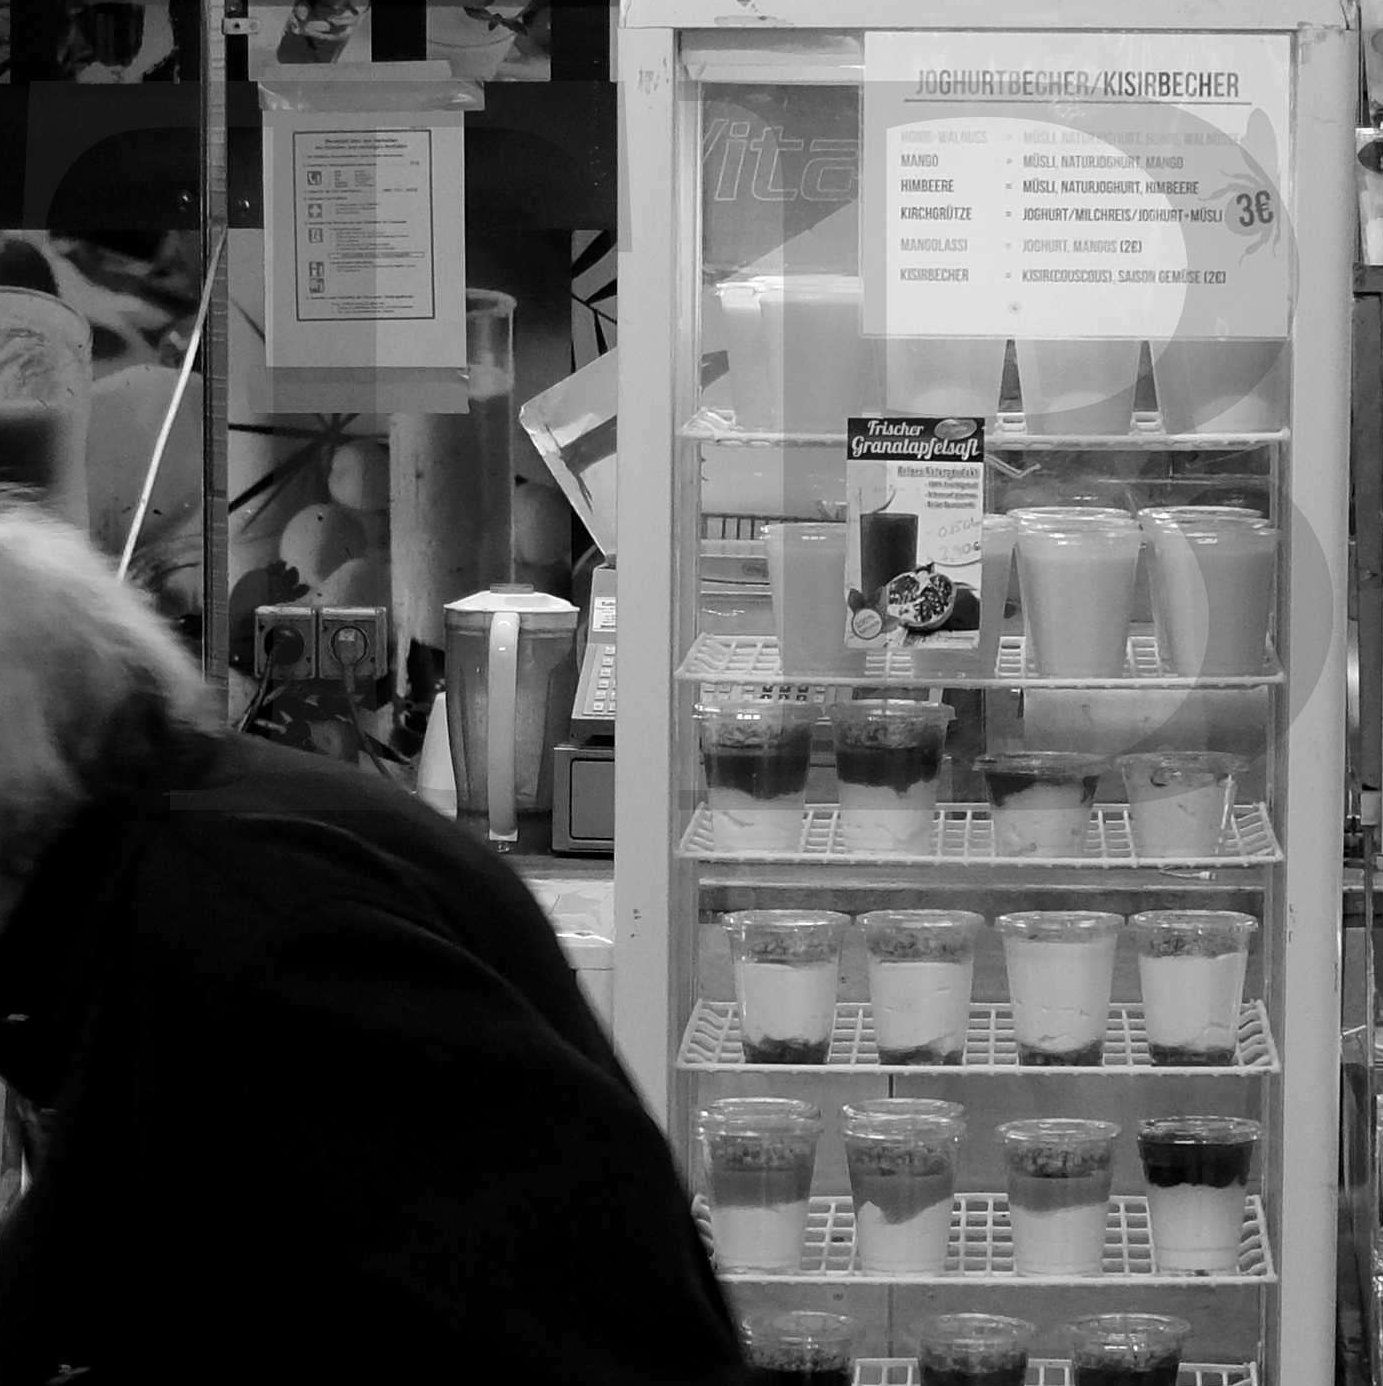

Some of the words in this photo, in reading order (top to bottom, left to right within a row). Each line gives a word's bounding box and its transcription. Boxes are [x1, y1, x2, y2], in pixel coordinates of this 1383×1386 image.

[916, 69, 1240, 98] JOGHURTBECHER/KISIRBECHER
[900, 153, 939, 167] MANGO
[900, 178, 954, 193] HIMBEERE
[1022, 178, 1059, 194] MÜSLI,
[1061, 180, 1143, 195] NATURJOGHURT,
[1145, 180, 1199, 195] HIMBEERE
[1235, 189, 1274, 228] 3€
[900, 237, 968, 252] MANGOLASSI
[899, 268, 970, 282] KISIRBECHER
[1118, 270, 1156, 283] SAISON
[867, 419, 924, 437] Frischer
[851, 435, 981, 461] Granatapfelsaft
